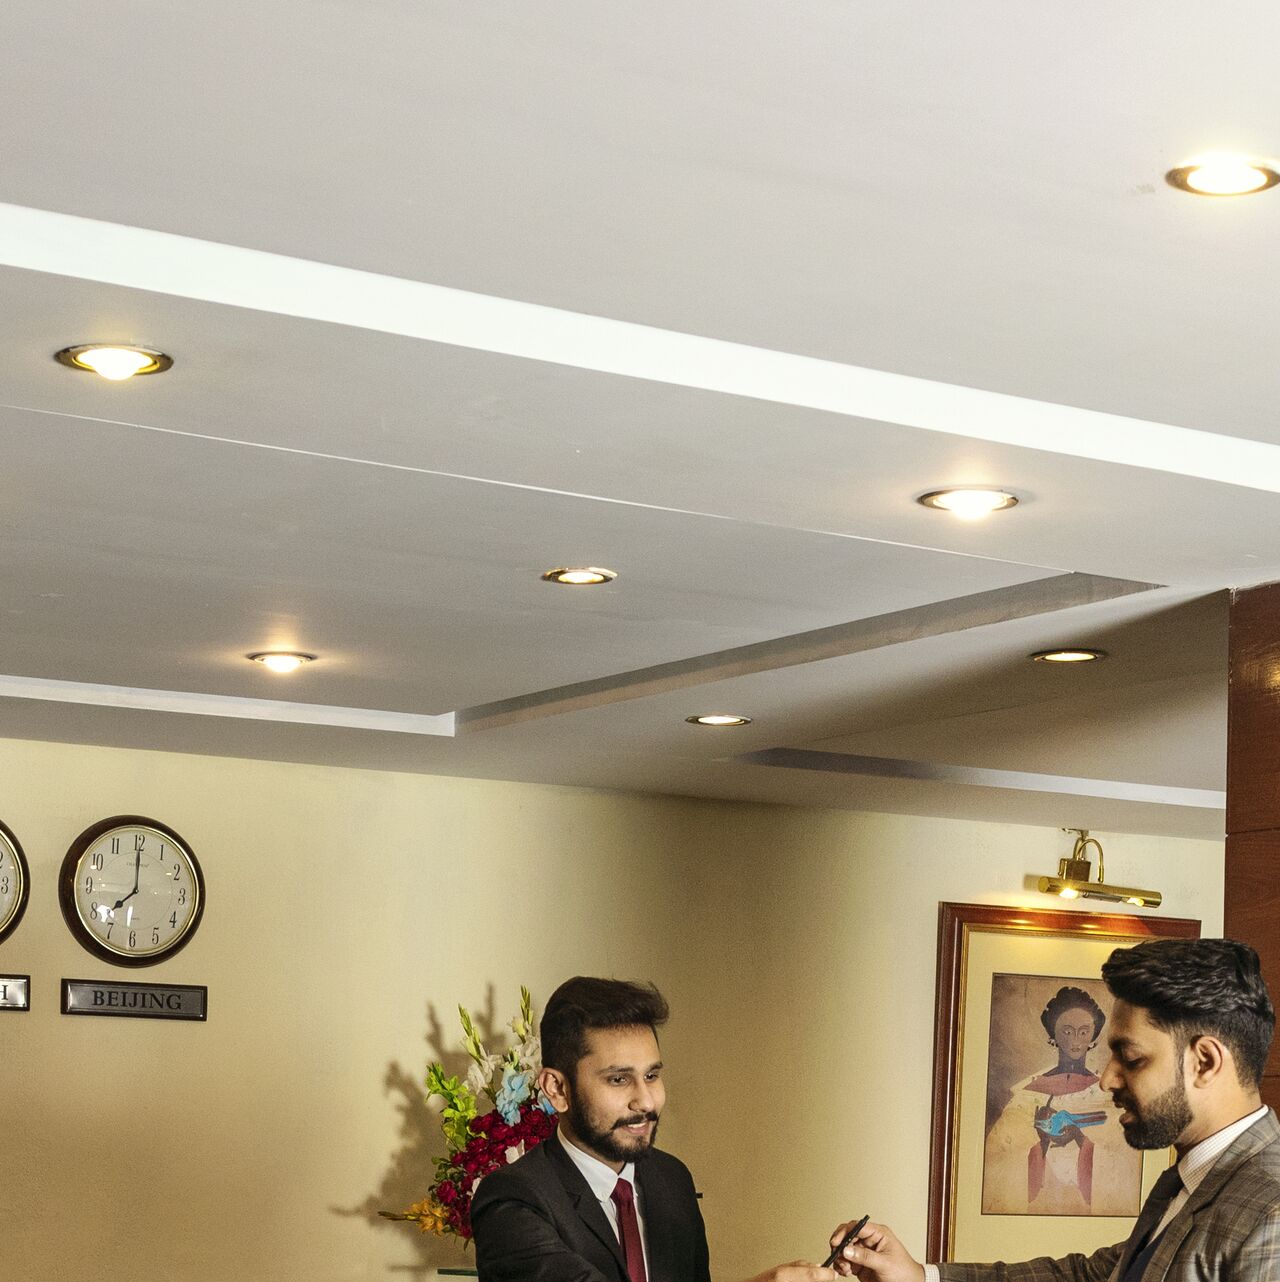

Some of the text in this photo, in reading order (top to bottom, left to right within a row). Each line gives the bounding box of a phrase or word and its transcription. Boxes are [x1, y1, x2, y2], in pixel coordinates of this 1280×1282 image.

[112, 838, 120, 855] 11
[134, 834, 146, 852] 12
[92, 853, 103, 872] 10
[173, 864, 180, 881] 2
[1, 876, 9, 894] 3
[86, 876, 93, 894] 9
[178, 888, 186, 905] 3
[90, 902, 98, 920] 8
[169, 911, 177, 928] 4
[107, 922, 114, 940] 7
[129, 930, 136, 948] 6
[152, 927, 159, 945] 5
[92, 990, 181, 1010] BEIJING
